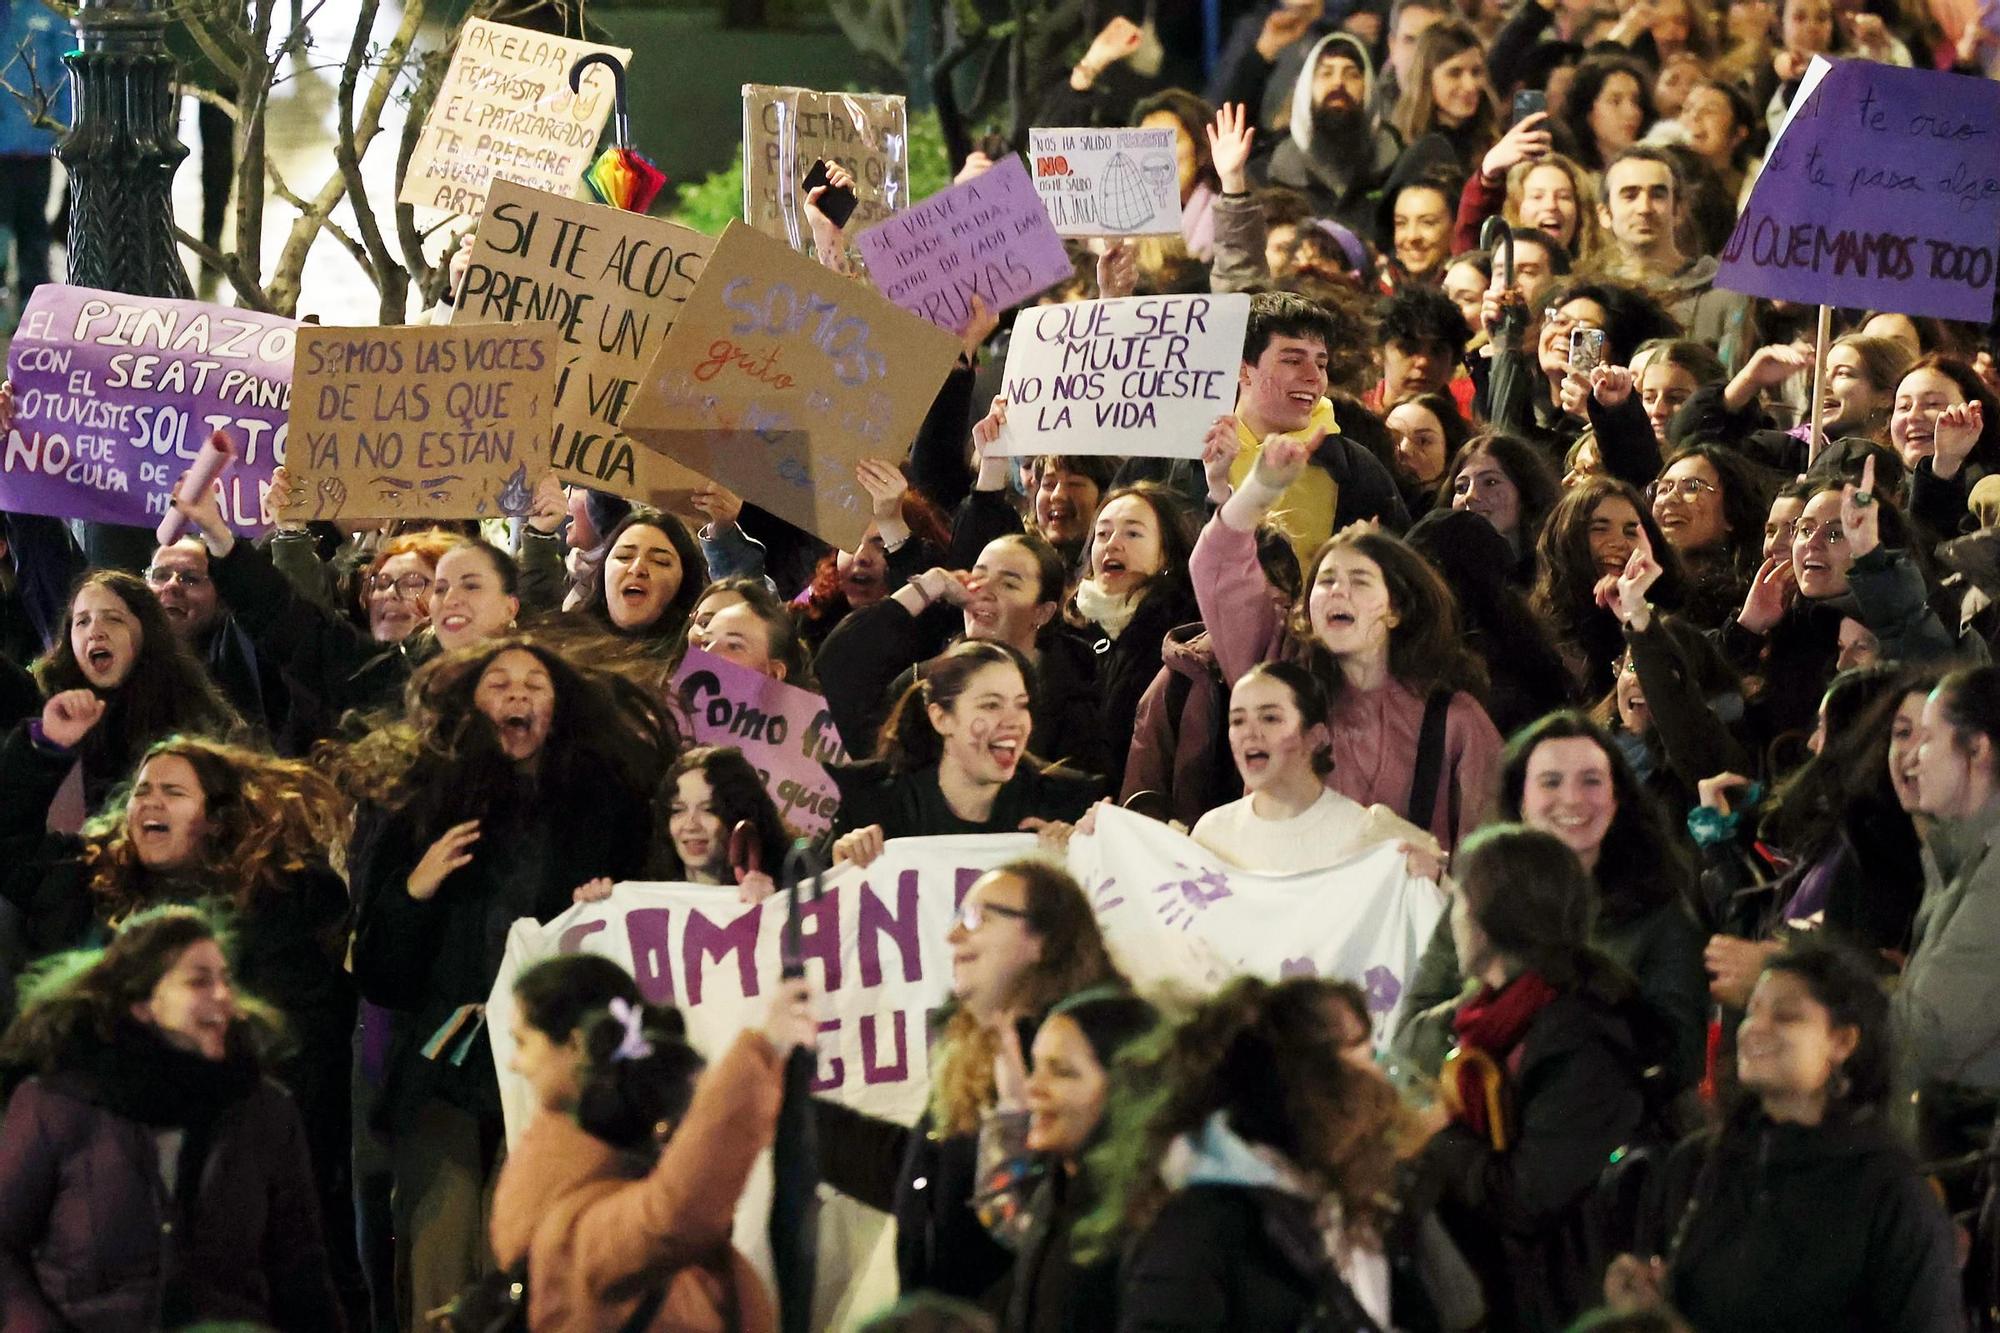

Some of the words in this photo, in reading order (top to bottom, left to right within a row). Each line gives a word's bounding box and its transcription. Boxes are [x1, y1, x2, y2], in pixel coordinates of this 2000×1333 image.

[444, 96, 473, 123] EL
[478, 103, 596, 150] PATRIARCADO
[1859, 86, 1887, 133] te
[436, 126, 463, 155] TE
[1062, 135, 1075, 151] HA
[1080, 134, 1112, 151] SALIDO
[1849, 168, 1925, 198] pasa
[485, 201, 540, 259] SI
[549, 217, 601, 281] TE
[871, 231, 894, 252] SE
[1752, 214, 1919, 282] QUEMAMOS
[1924, 238, 1994, 290] TODO
[910, 251, 1033, 327] RUXAS
[25, 310, 59, 342] EL
[72, 299, 297, 363] PINAZO
[598, 303, 650, 360] UN
[1036, 301, 1126, 347] QUE
[1134, 298, 1211, 337] SER
[17, 347, 72, 375] CON
[67, 370, 97, 396] EL
[105, 353, 223, 396] SEAT
[306, 339, 404, 377] SOMOS
[415, 340, 457, 374] LAS
[464, 338, 546, 372] VOCES
[1061, 335, 1190, 374] MUJER
[317, 383, 361, 422] DE
[373, 383, 431, 423] LAS
[445, 381, 513, 431] QUE
[1007, 377, 1043, 406] NO
[1052, 372, 1106, 401] NOS
[1121, 370, 1226, 401] CUESTE
[16, 389, 42, 421] O
[44, 394, 137, 432] TUVISTE
[1037, 406, 1073, 433] LA
[1095, 402, 1157, 430] VIDA
[4, 429, 71, 475] NO
[75, 433, 118, 464] FUE
[306, 431, 340, 471] YA
[353, 431, 403, 469] NO
[66, 462, 129, 493] CULPA
[139, 461, 170, 486] DE
